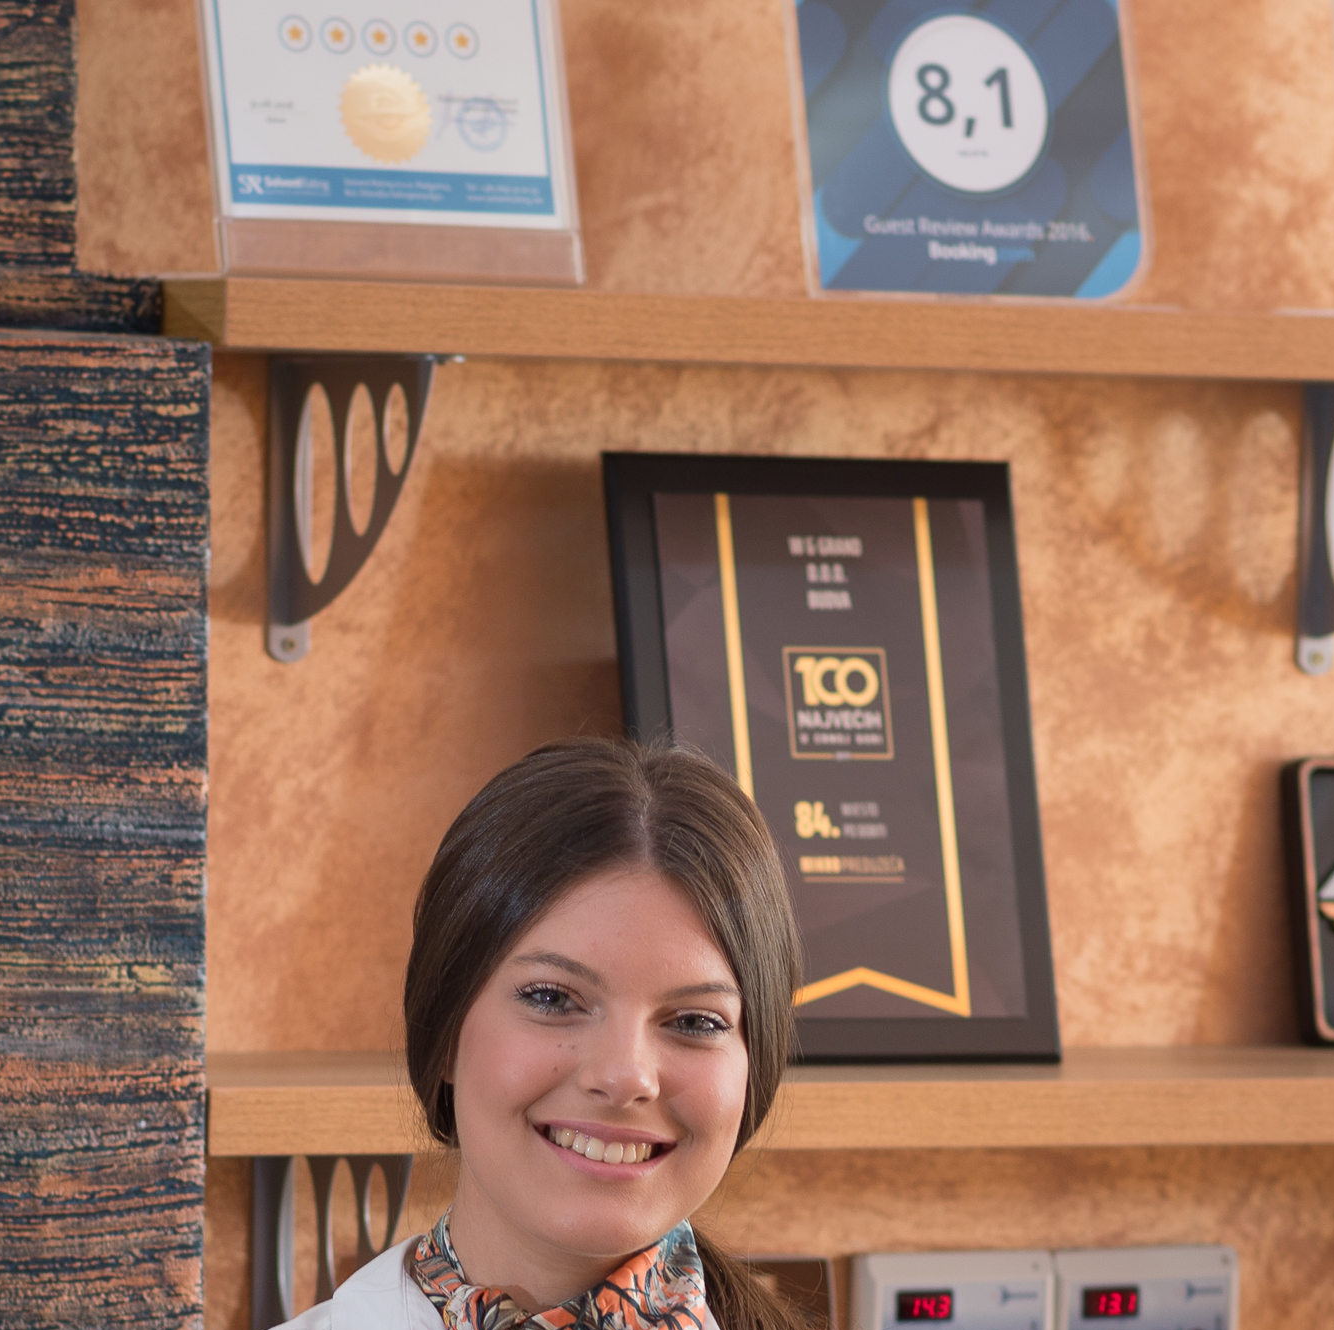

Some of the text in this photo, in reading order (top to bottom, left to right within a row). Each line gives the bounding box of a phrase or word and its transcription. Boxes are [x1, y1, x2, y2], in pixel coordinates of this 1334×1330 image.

[916, 62, 1015, 139] 8,1
[864, 214, 916, 236] Guest
[918, 216, 979, 238] Review
[981, 219, 1044, 241] Awards
[795, 657, 879, 707] 100
